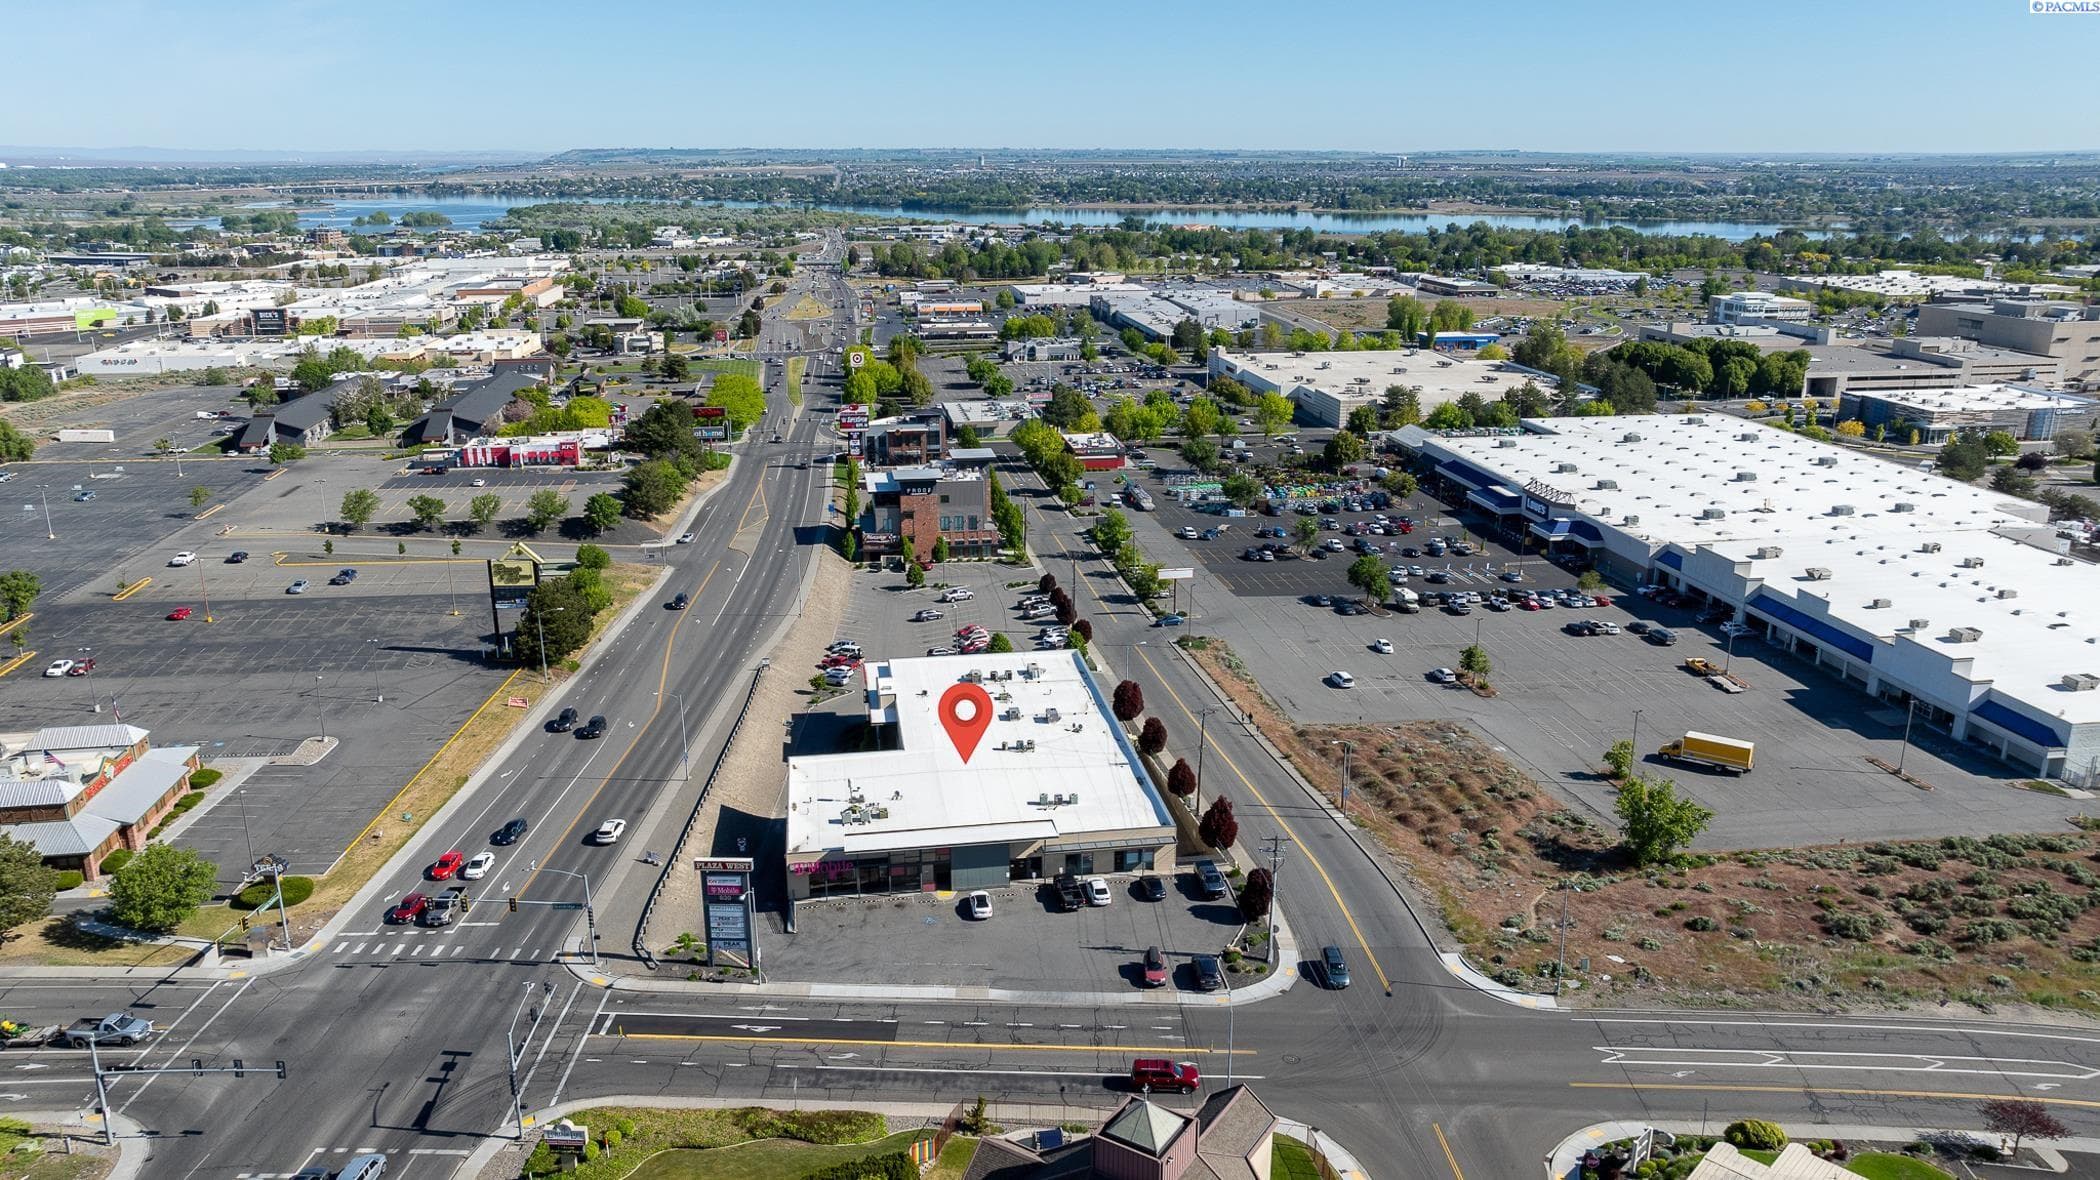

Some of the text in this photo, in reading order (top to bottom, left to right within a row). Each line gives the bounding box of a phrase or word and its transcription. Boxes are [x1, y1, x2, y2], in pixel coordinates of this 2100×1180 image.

[1526, 497, 1546, 515] LOWE'S
[725, 862, 750, 870] WEST
[717, 886, 740, 895] Mobile
